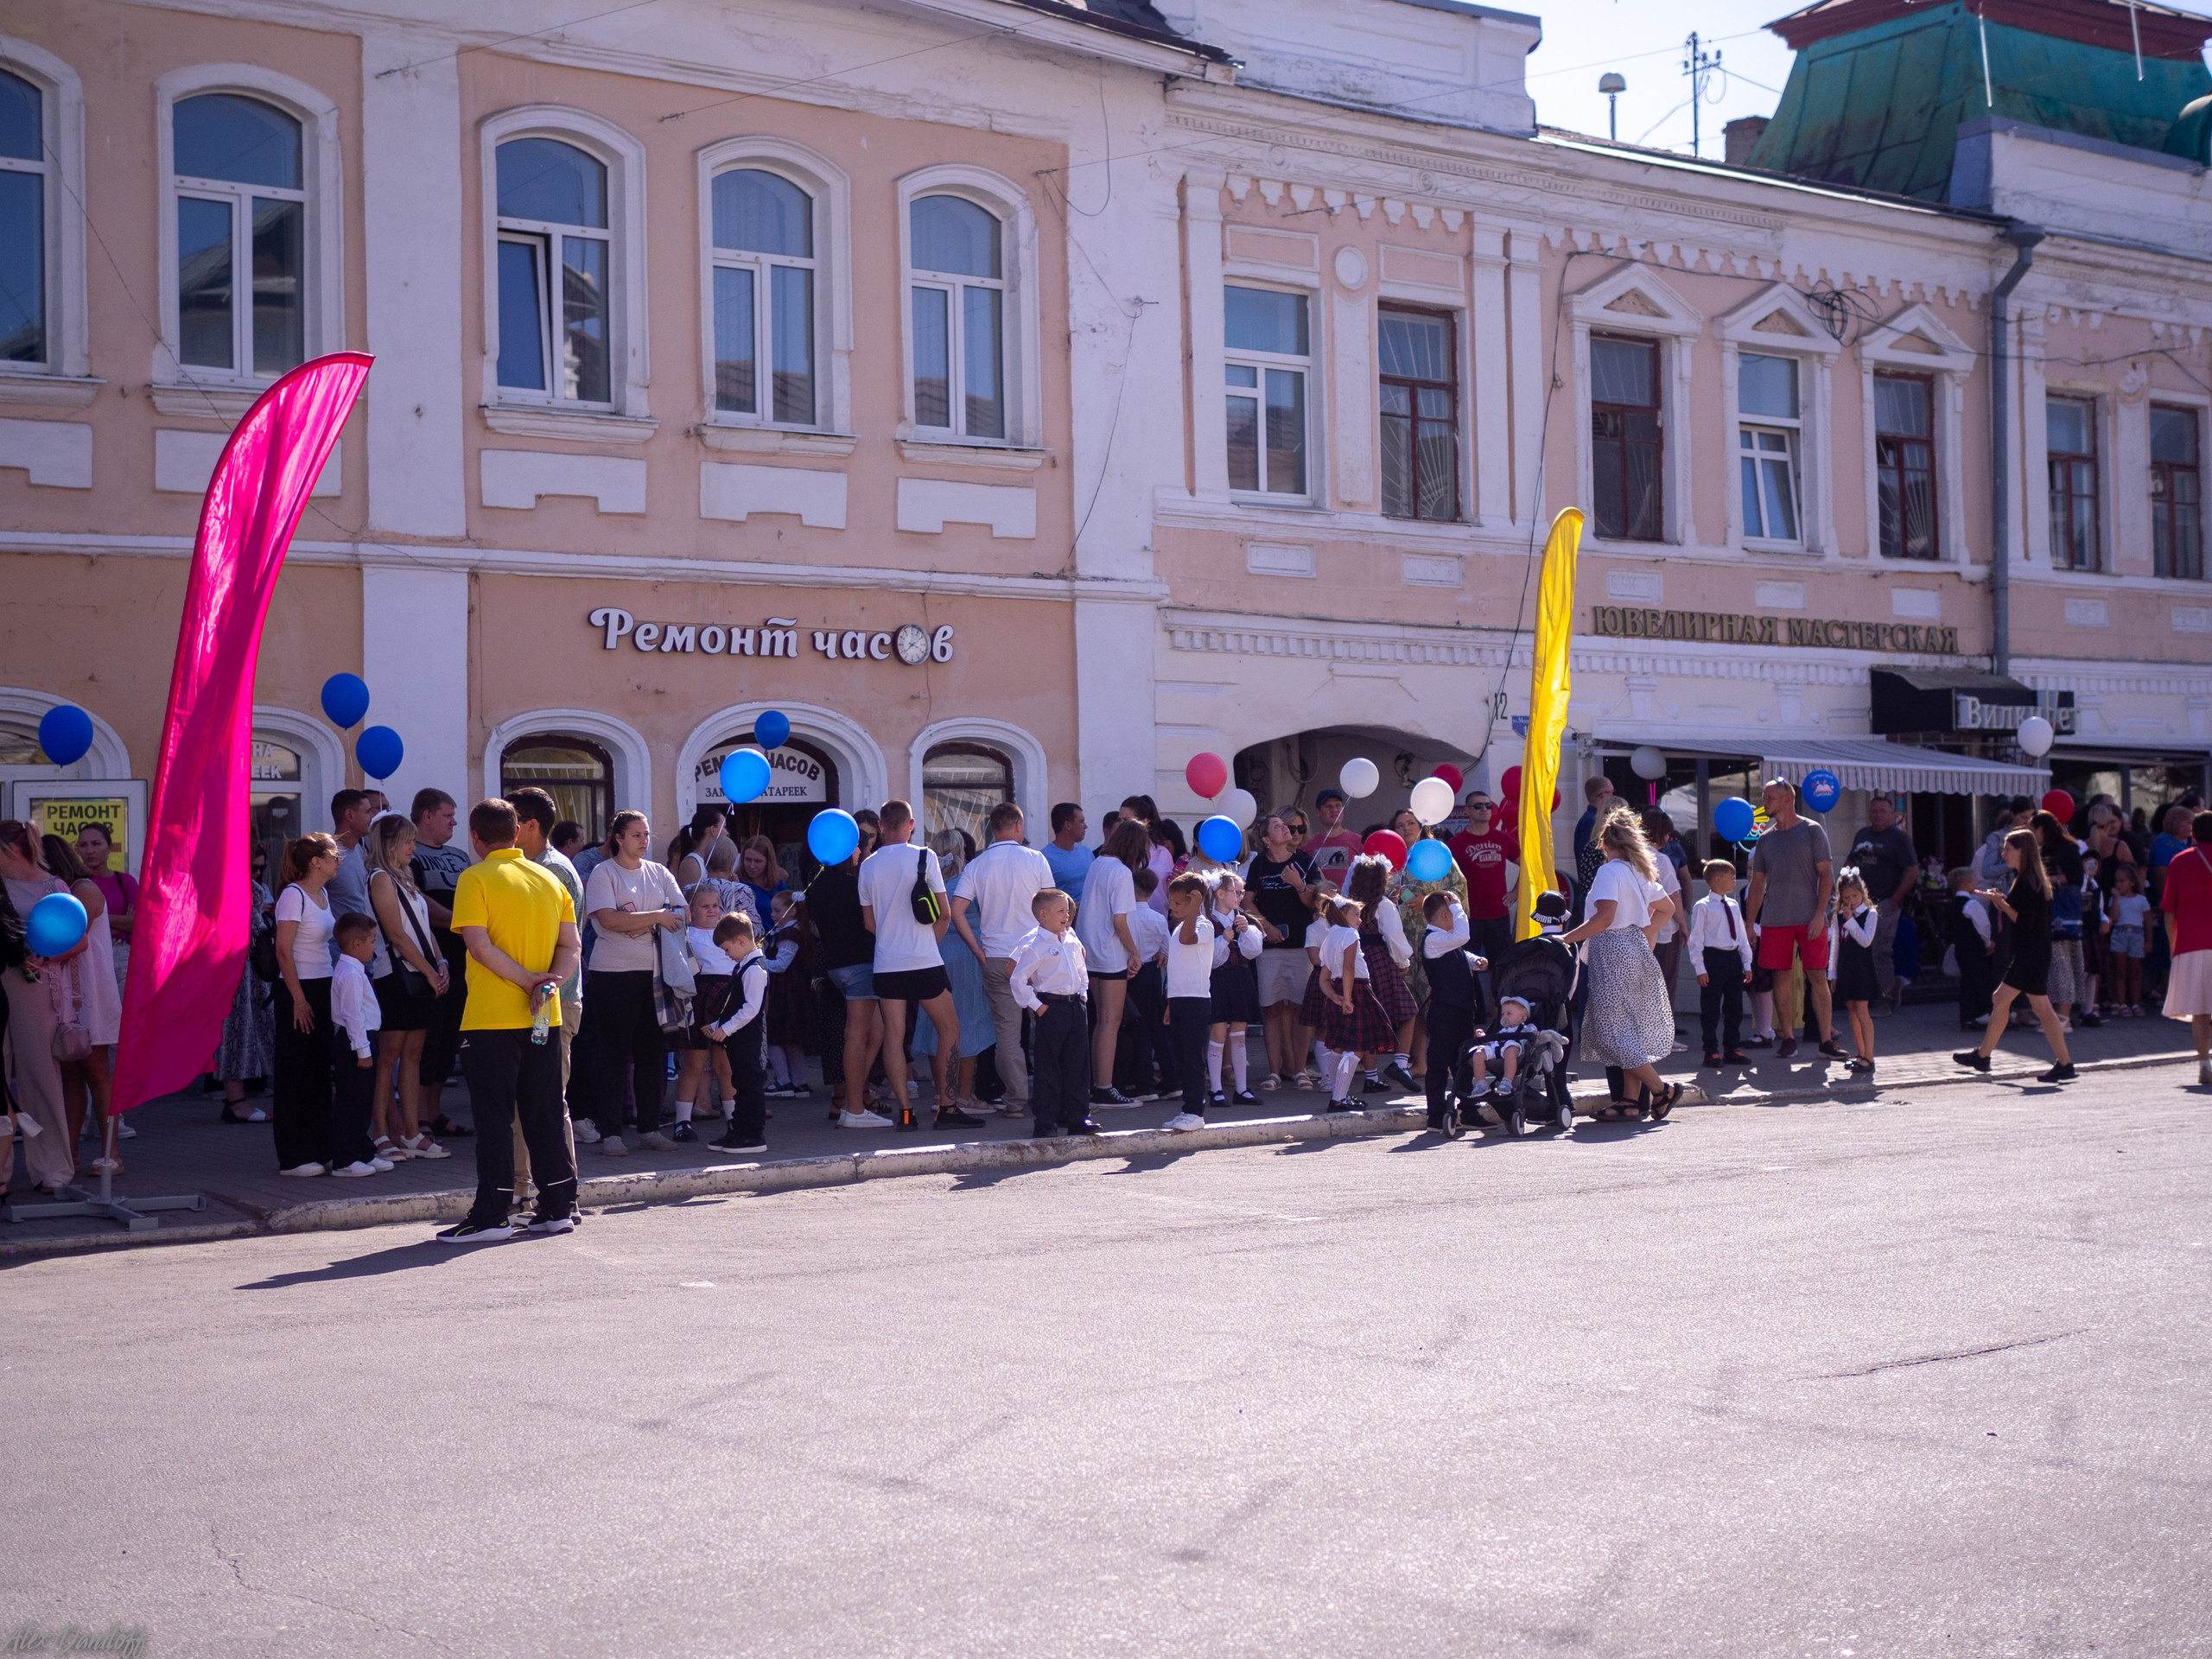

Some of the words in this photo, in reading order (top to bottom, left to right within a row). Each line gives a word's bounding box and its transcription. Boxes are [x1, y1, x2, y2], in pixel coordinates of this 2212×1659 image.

[588, 607, 799, 658] Ремонт
[1594, 606, 1778, 644] ЮВЕЛИРНАЯ
[1788, 617, 1960, 653] МАСТЕРСКАЯ
[1495, 692, 1508, 721] 12
[252, 743, 275, 758] НА
[251, 765, 283, 779] ЕЕК
[695, 754, 726, 783] РЕМ
[761, 786, 807, 797] АТАРЕЕК
[47, 804, 121, 819] РЕМОНТ
[54, 822, 114, 836] ЧАСВ
[1465, 841, 1503, 857] Denim
[1532, 912, 1552, 925] PUMA
